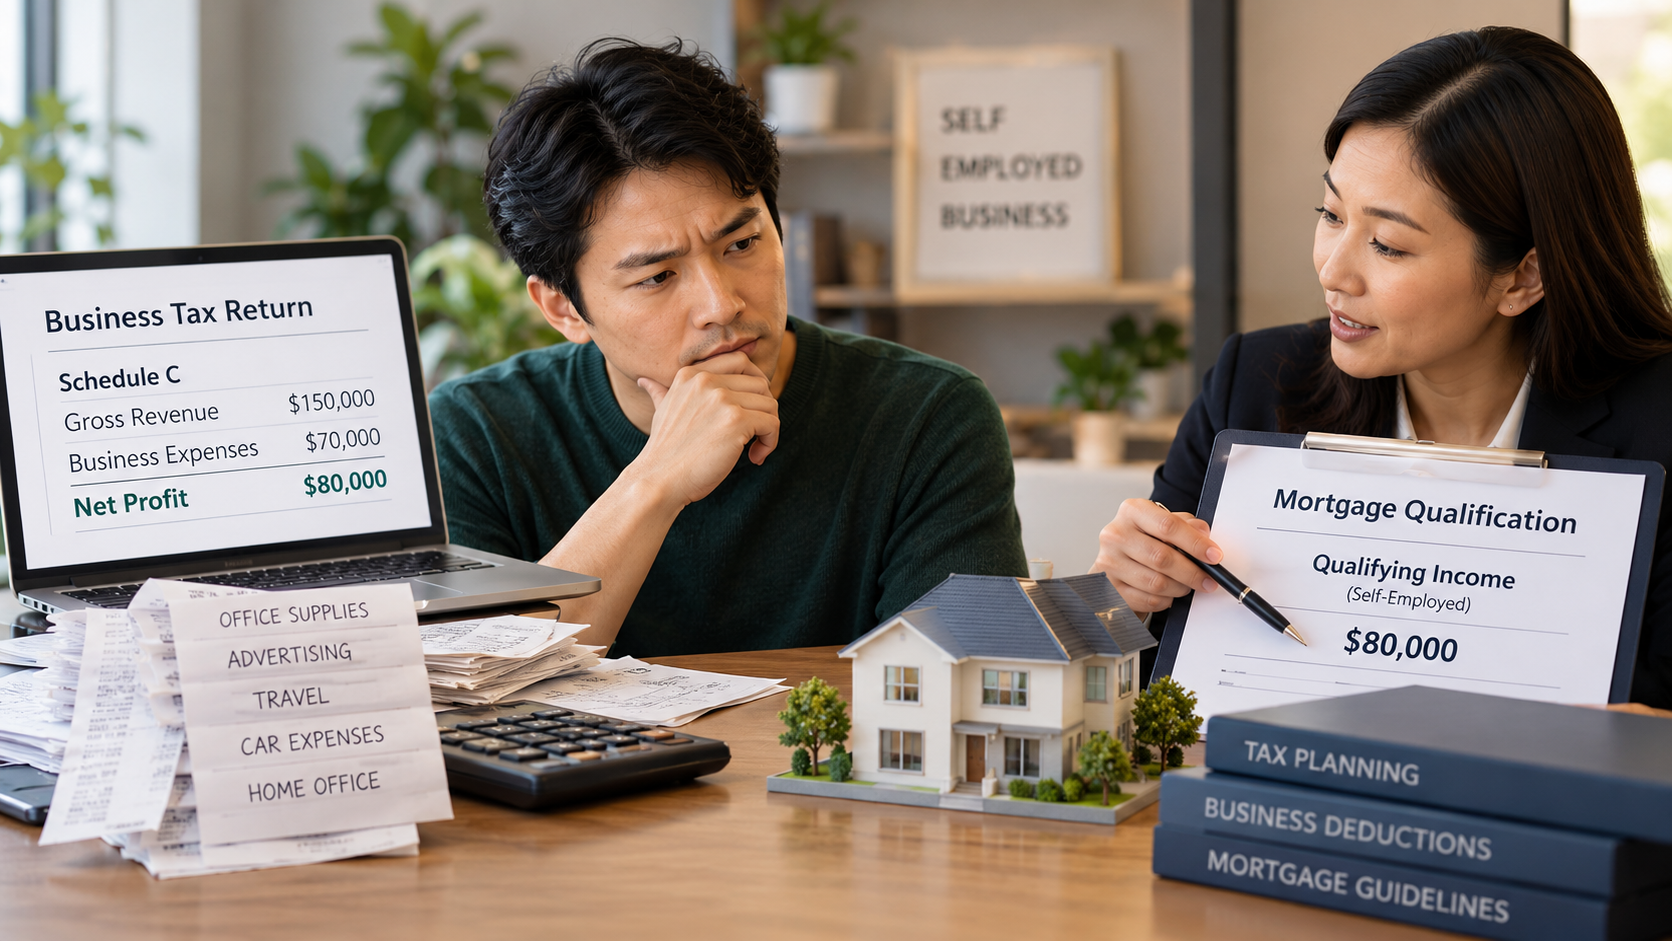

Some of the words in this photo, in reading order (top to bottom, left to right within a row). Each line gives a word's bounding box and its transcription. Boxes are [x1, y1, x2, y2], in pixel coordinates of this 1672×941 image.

[940, 105, 1006, 133] SELF
[940, 154, 1083, 181] EMPLOYED
[941, 203, 1069, 229] BUSINESS
[44, 306, 164, 333] Business
[169, 302, 218, 325] Tax
[224, 299, 313, 322] Return
[59, 366, 160, 393] Schedule
[165, 365, 181, 384] C
[64, 412, 125, 432] Gross
[131, 406, 219, 427] Revenue
[288, 388, 375, 416] $150,000
[69, 451, 160, 473] Business
[165, 442, 259, 467] Expenses
[305, 427, 381, 453] $70,000
[73, 496, 118, 518] Net
[123, 488, 190, 513] Profit
[303, 469, 387, 498] $80,000
[1273, 488, 1397, 523] Mortgage
[1404, 499, 1577, 534] Qualification
[1312, 553, 1427, 587] Qualifying
[1432, 564, 1516, 590] Income
[219, 607, 282, 628] OFFICE
[288, 601, 369, 623] SUPPLIES
[1346, 585, 1471, 615] (Self-Employed)
[228, 642, 352, 669] ADVERTISING
[1343, 626, 1458, 663] $80,000
[252, 687, 330, 710] TRAVEL
[240, 734, 282, 756] CAR
[288, 724, 385, 752] EXPENSES
[1244, 740, 1288, 766] TAX
[1294, 747, 1419, 786] PLANNING
[248, 778, 306, 803] HOME
[313, 770, 381, 796] OFFICE
[1204, 796, 1317, 834] BUSINESS
[1324, 814, 1492, 861] DEDUCTIONS
[1207, 849, 1348, 895] MORTGAGE
[1355, 875, 1510, 923] GUIDELINES
